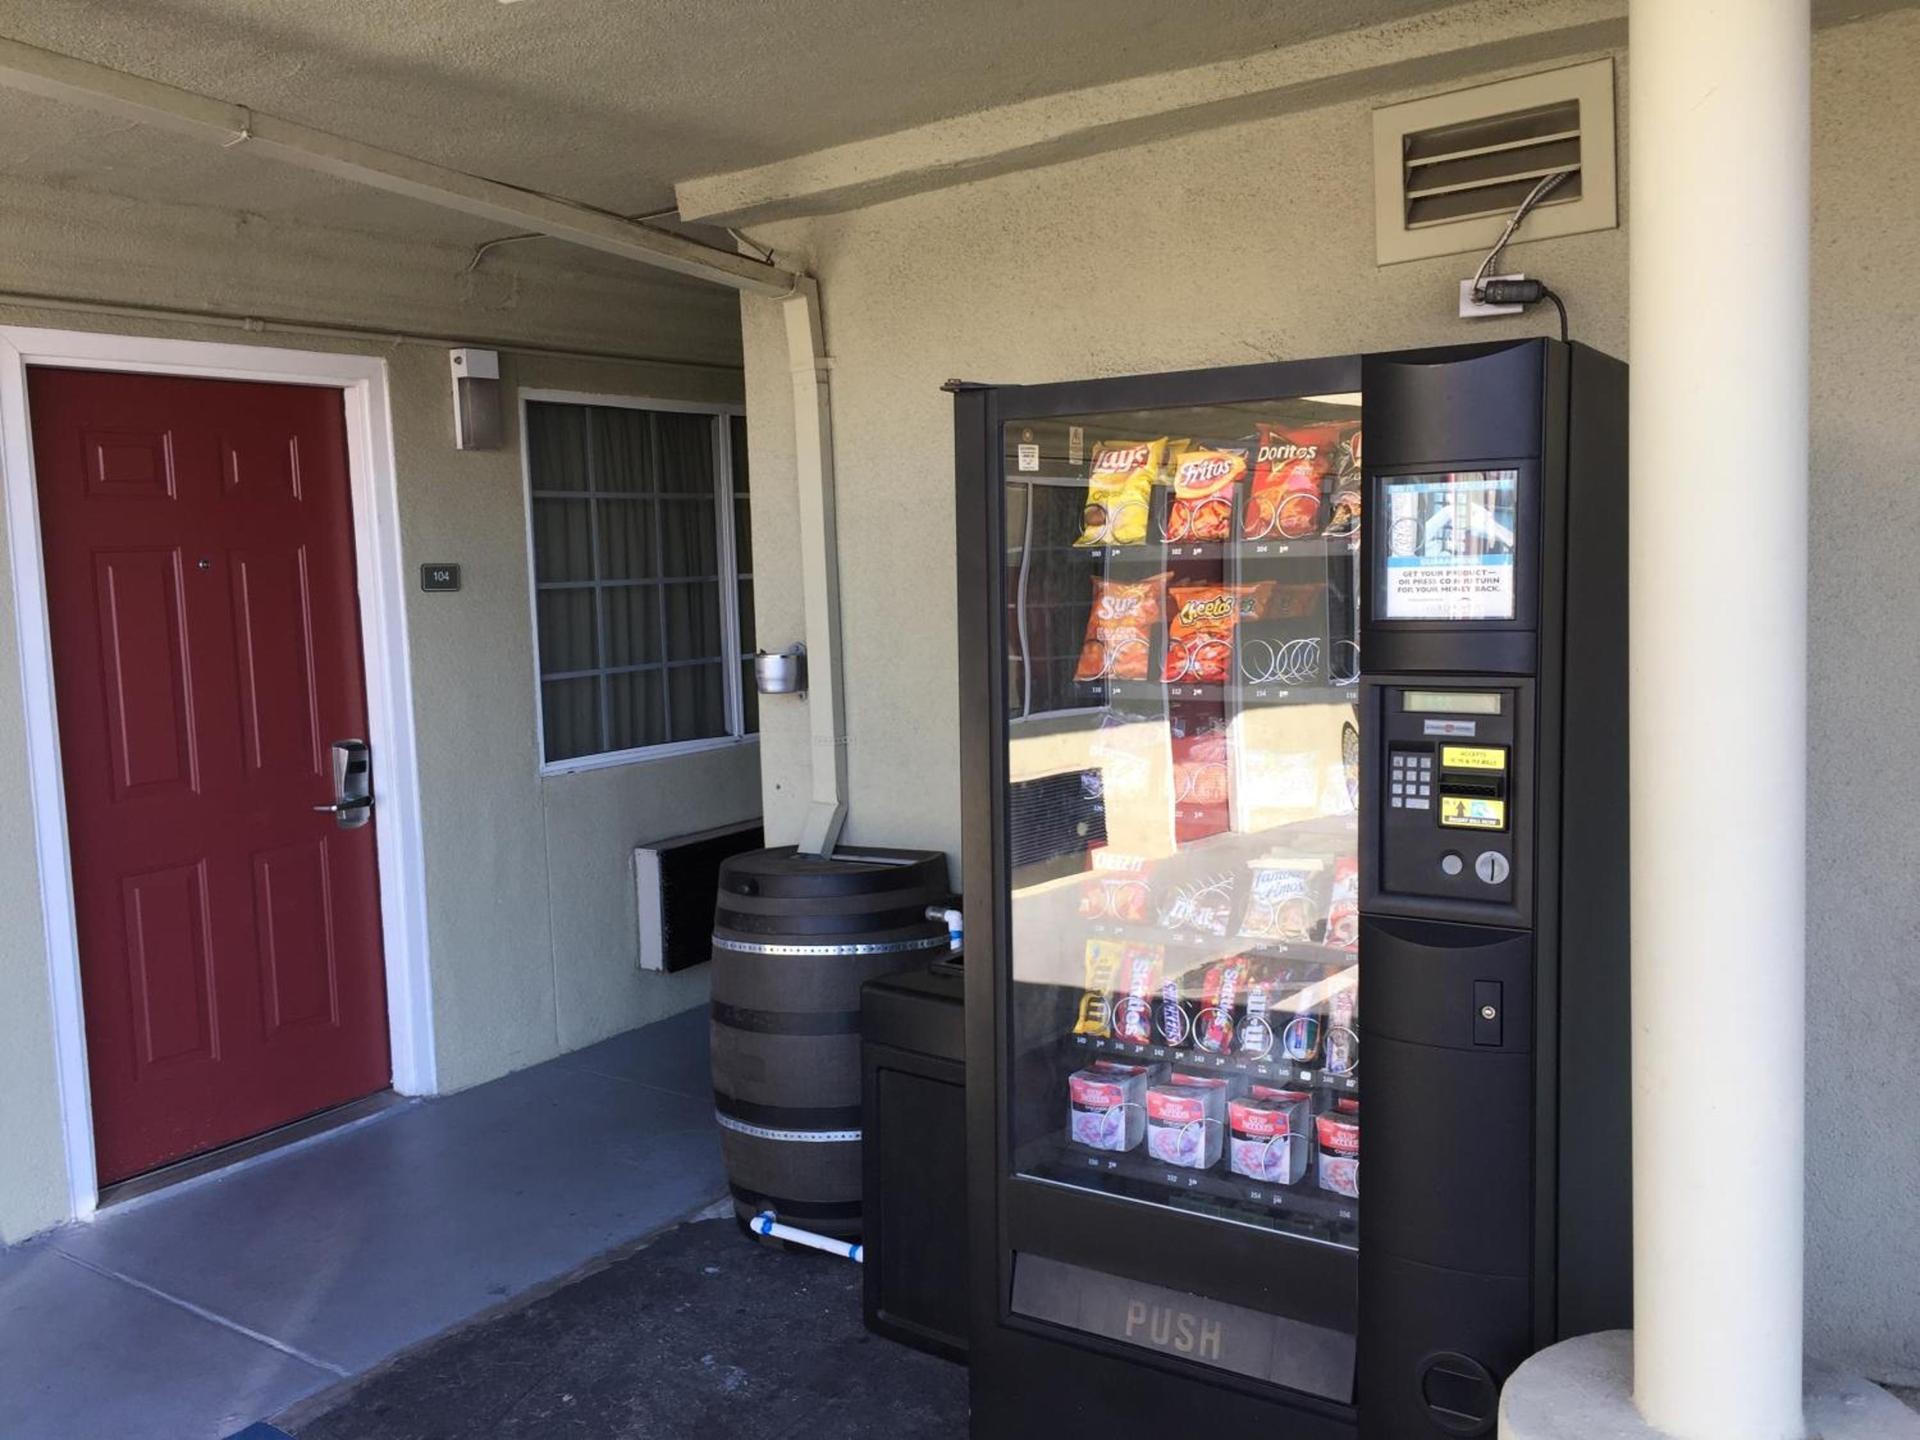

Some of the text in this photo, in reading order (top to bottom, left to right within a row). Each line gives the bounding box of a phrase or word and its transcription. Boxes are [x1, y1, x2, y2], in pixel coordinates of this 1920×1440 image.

[1257, 445, 1318, 463] Doritos
[1181, 459, 1233, 486] Fritos
[434, 570, 449, 582] 104
[1402, 570, 1418, 578] GET
[1421, 569, 1443, 577] YOUR
[1180, 596, 1234, 626] Cheetos
[1126, 1300, 1221, 1360] PUSH
